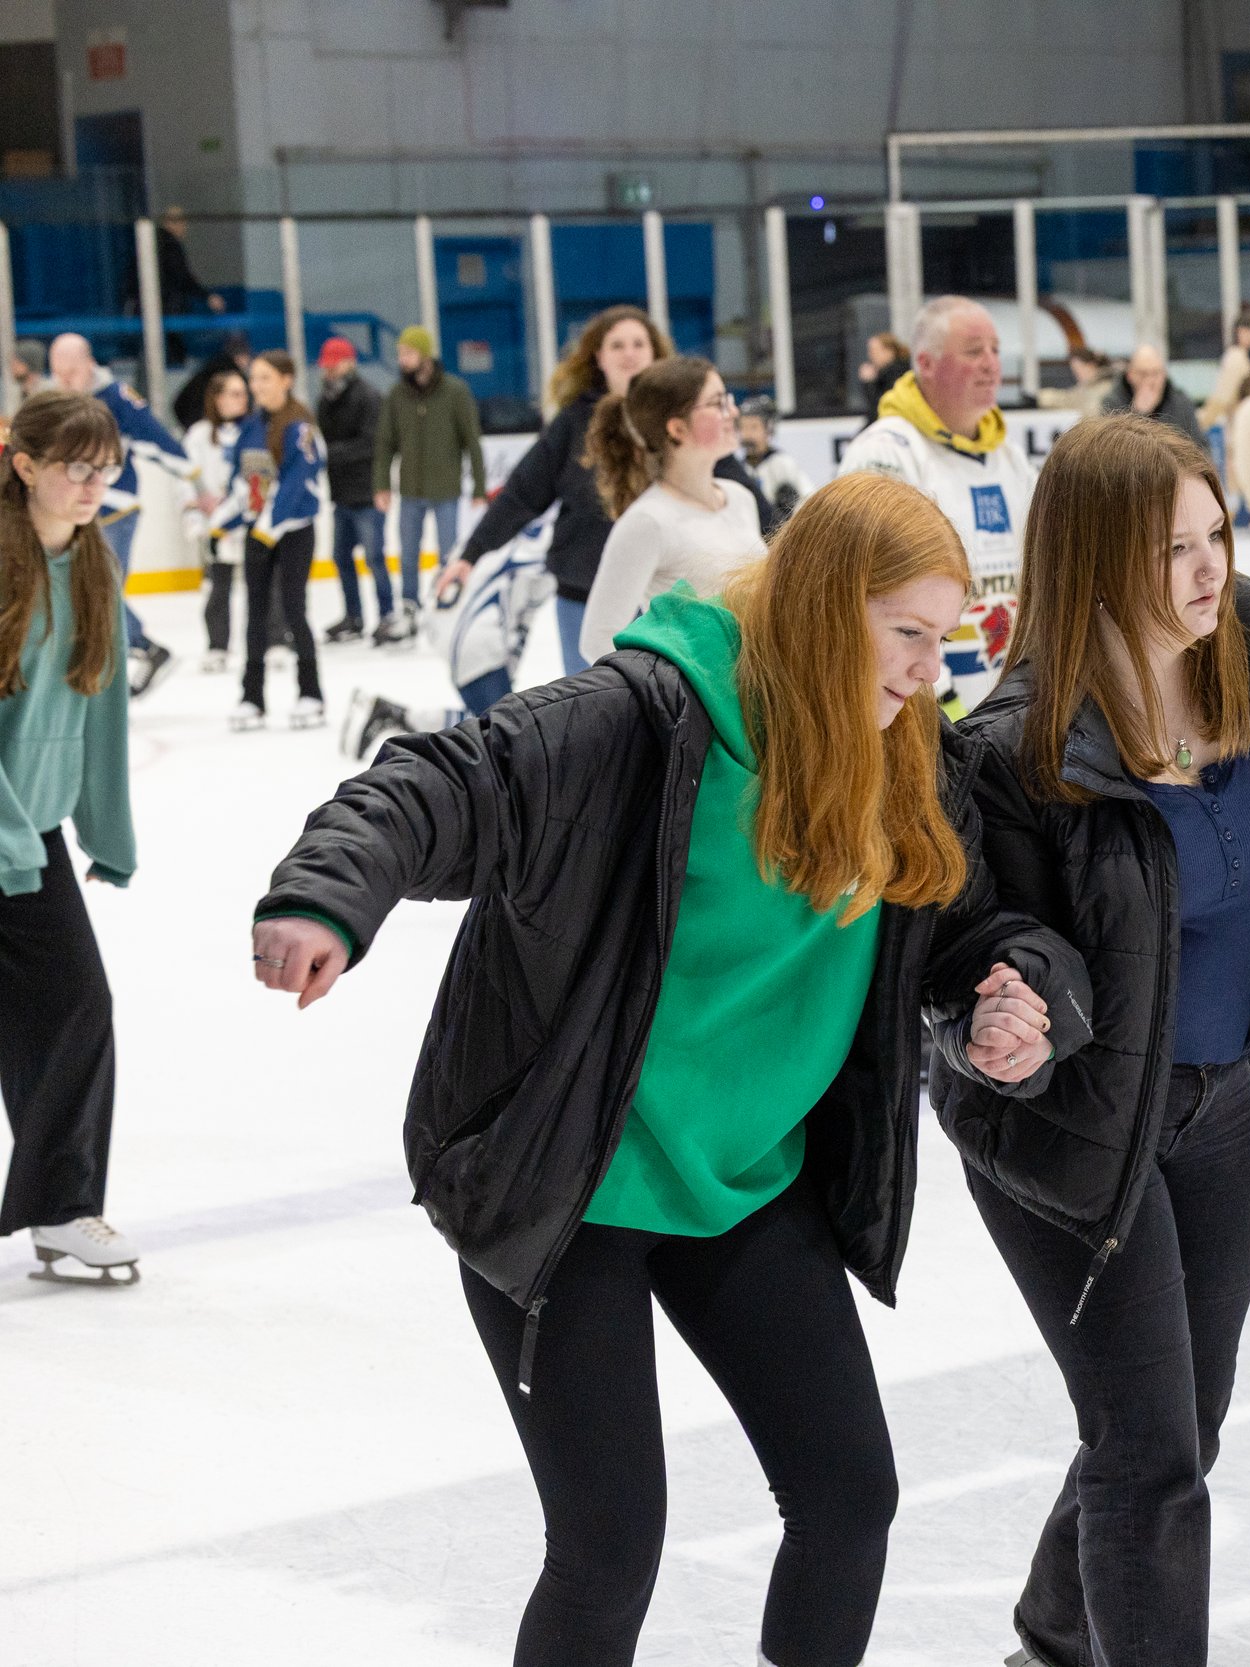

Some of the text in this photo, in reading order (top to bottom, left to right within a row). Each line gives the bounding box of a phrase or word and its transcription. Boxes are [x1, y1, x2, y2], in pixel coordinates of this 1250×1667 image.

[1069, 1275, 1095, 1325] THE NORTH FACE
